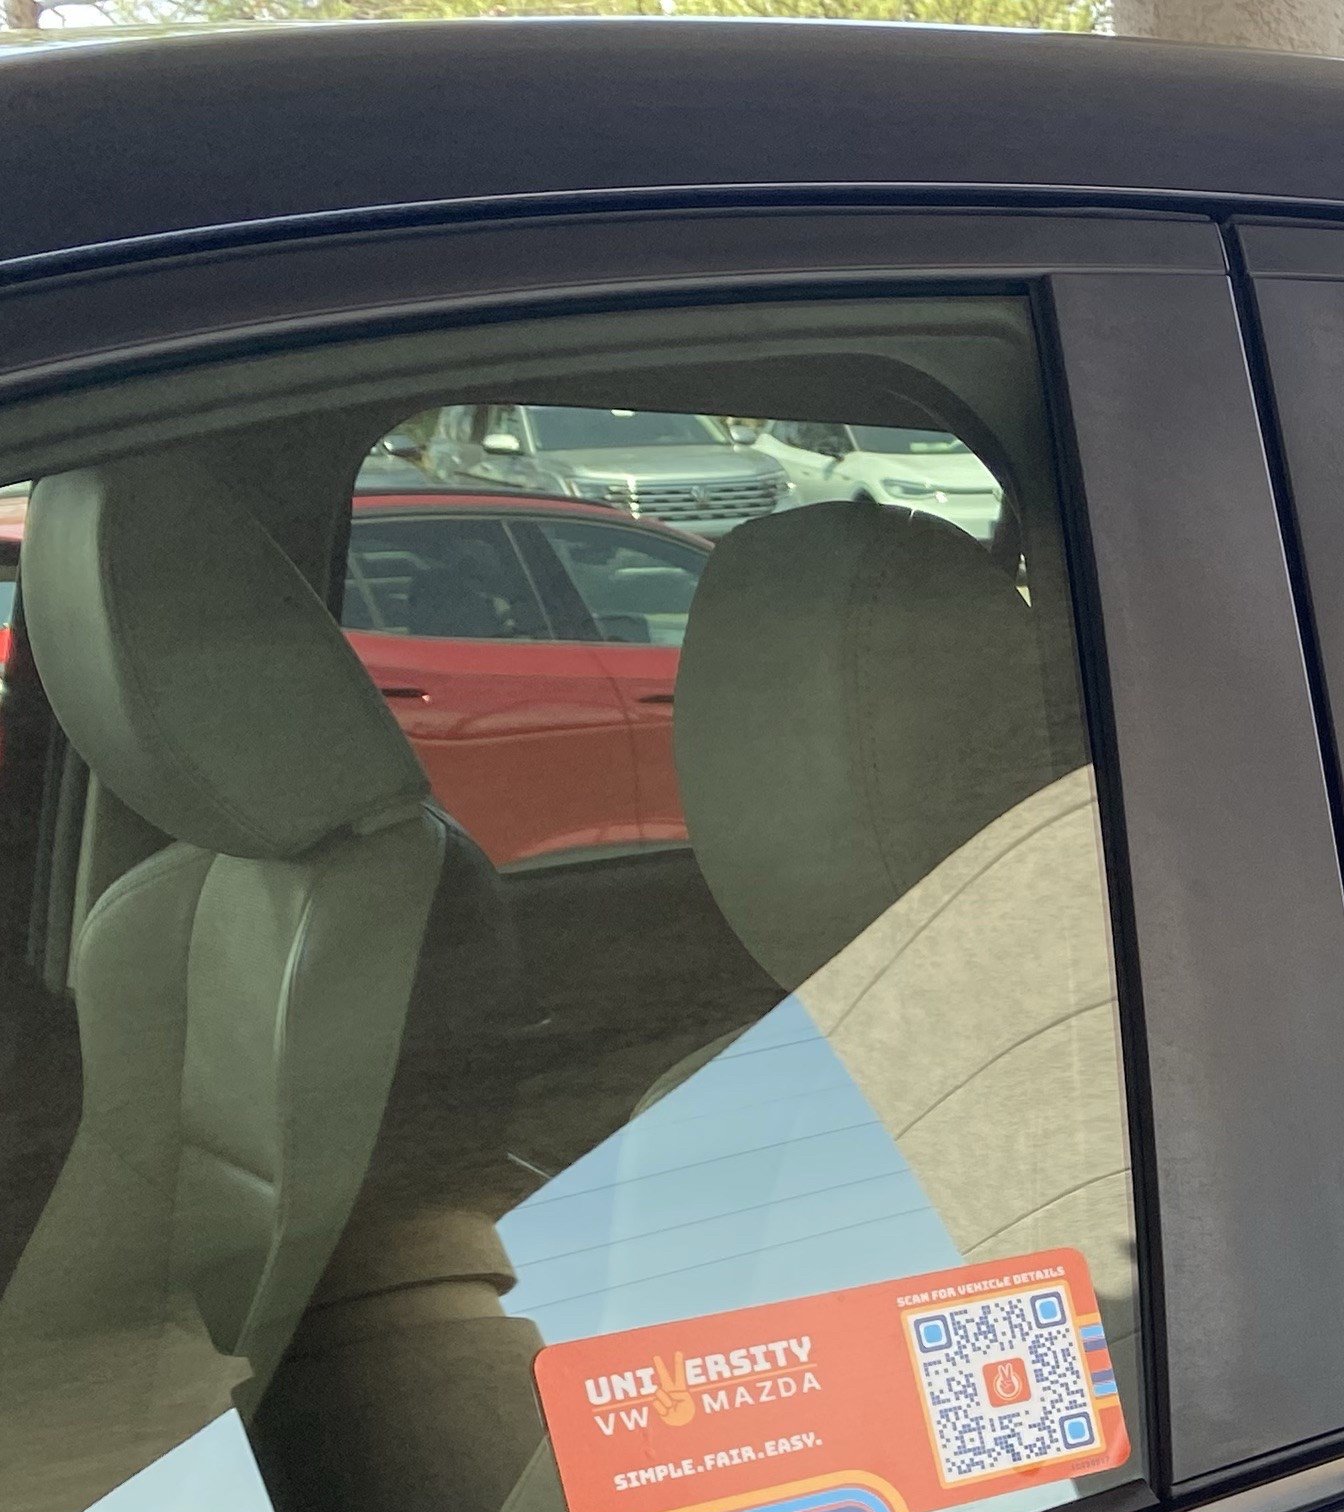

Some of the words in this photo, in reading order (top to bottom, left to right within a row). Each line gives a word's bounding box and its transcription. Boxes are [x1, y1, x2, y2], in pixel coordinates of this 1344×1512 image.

[896, 1292, 928, 1308] SCAN
[930, 1287, 956, 1302] FOR
[957, 1276, 1010, 1297] VEHICLE
[1012, 1266, 1066, 1287] DETAILS
[593, 1404, 650, 1436] VW
[702, 1371, 822, 1416] MAZDA
